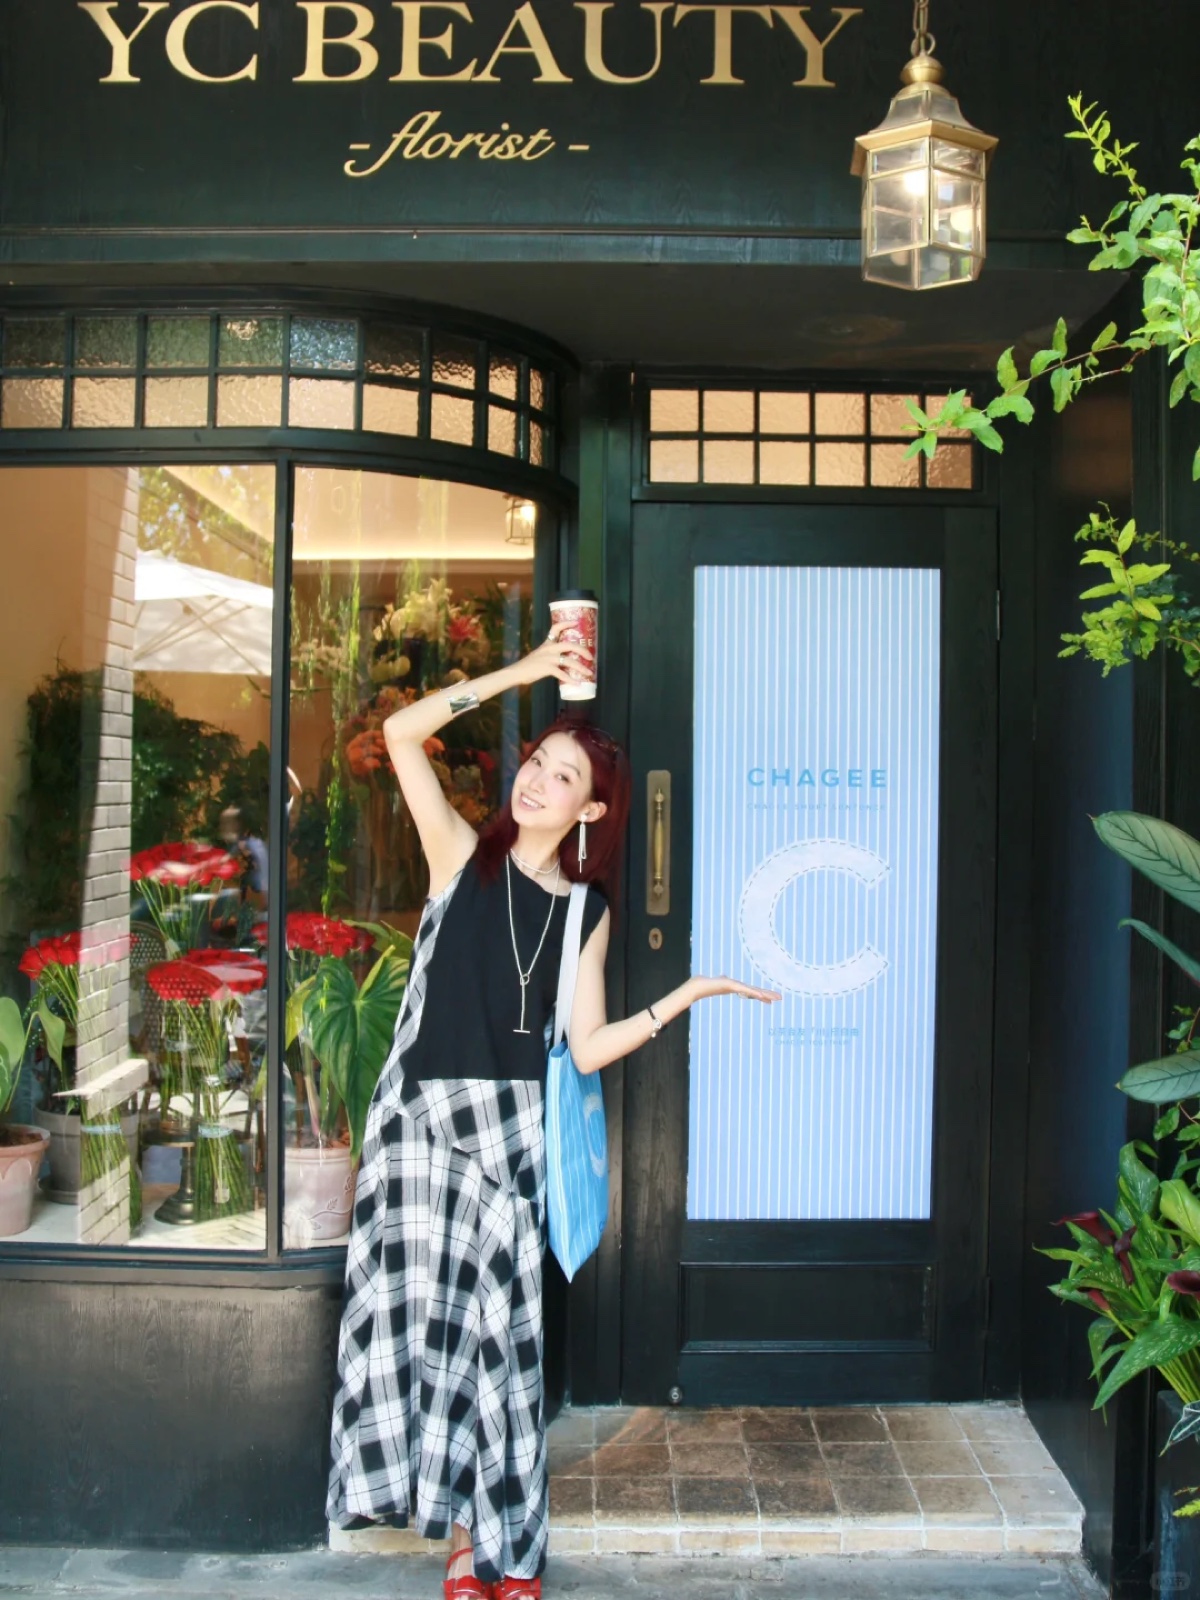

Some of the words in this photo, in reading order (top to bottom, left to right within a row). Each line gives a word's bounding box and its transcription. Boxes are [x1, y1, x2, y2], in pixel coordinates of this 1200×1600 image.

[77, 1, 260, 83] YC
[291, 1, 864, 88] BEAUTY
[343, 111, 556, 177] florist
[747, 767, 887, 788] CHAGEE
